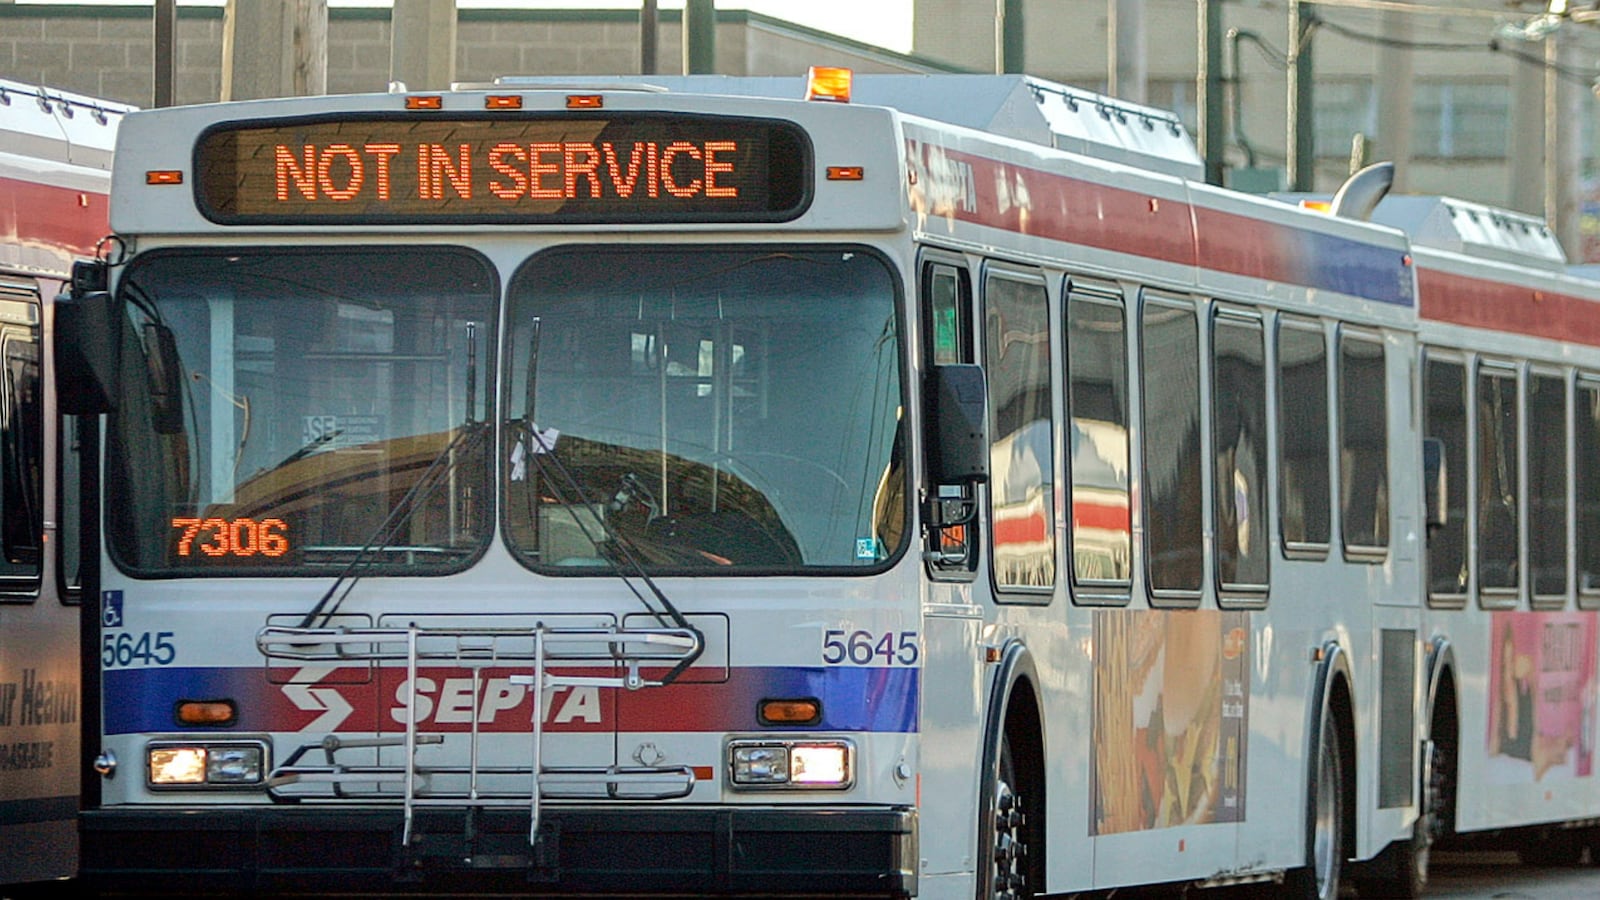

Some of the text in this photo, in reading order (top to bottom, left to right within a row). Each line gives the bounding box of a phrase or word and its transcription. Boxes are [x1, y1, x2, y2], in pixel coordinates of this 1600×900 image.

[276, 140, 738, 201] NOT IN SERVICE
[172, 517, 288, 556] 7306
[102, 632, 175, 667] 5645
[822, 629, 919, 666] 5645
[390, 677, 602, 724] SEPTA
